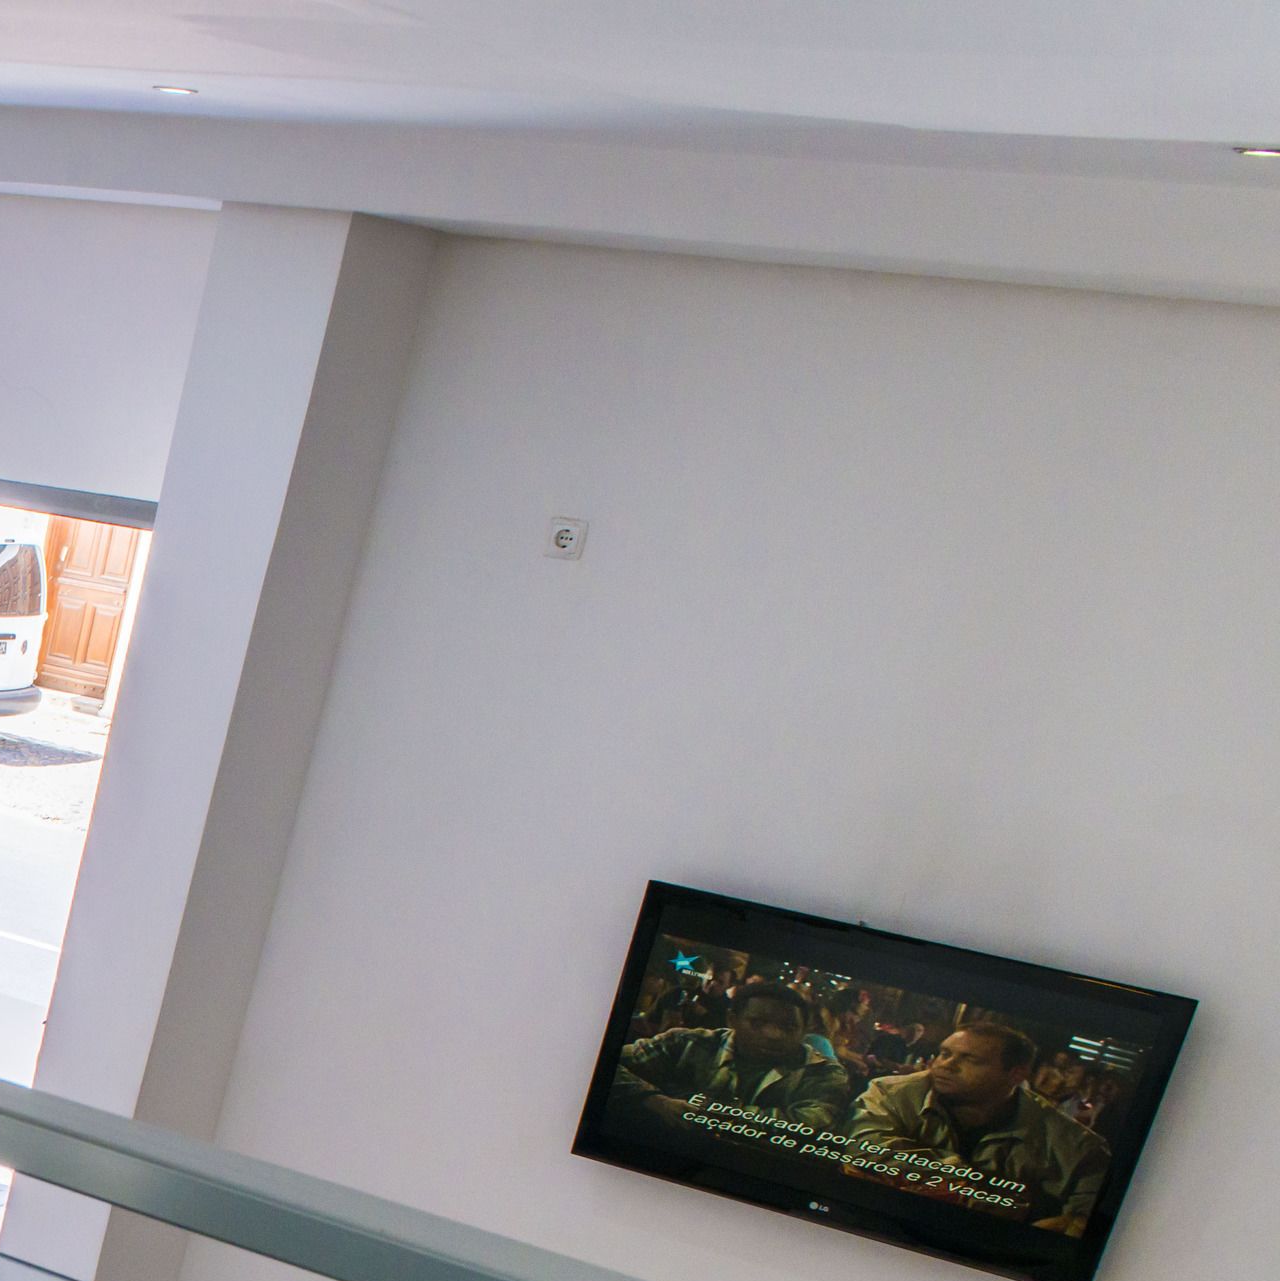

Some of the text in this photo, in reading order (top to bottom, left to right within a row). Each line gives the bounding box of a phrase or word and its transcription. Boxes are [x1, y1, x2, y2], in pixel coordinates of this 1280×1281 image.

[683, 1111, 1019, 1209] caçador de pássaros e 2 vacas.
[687, 1093, 1026, 1193] É procurado por ter atacado um
